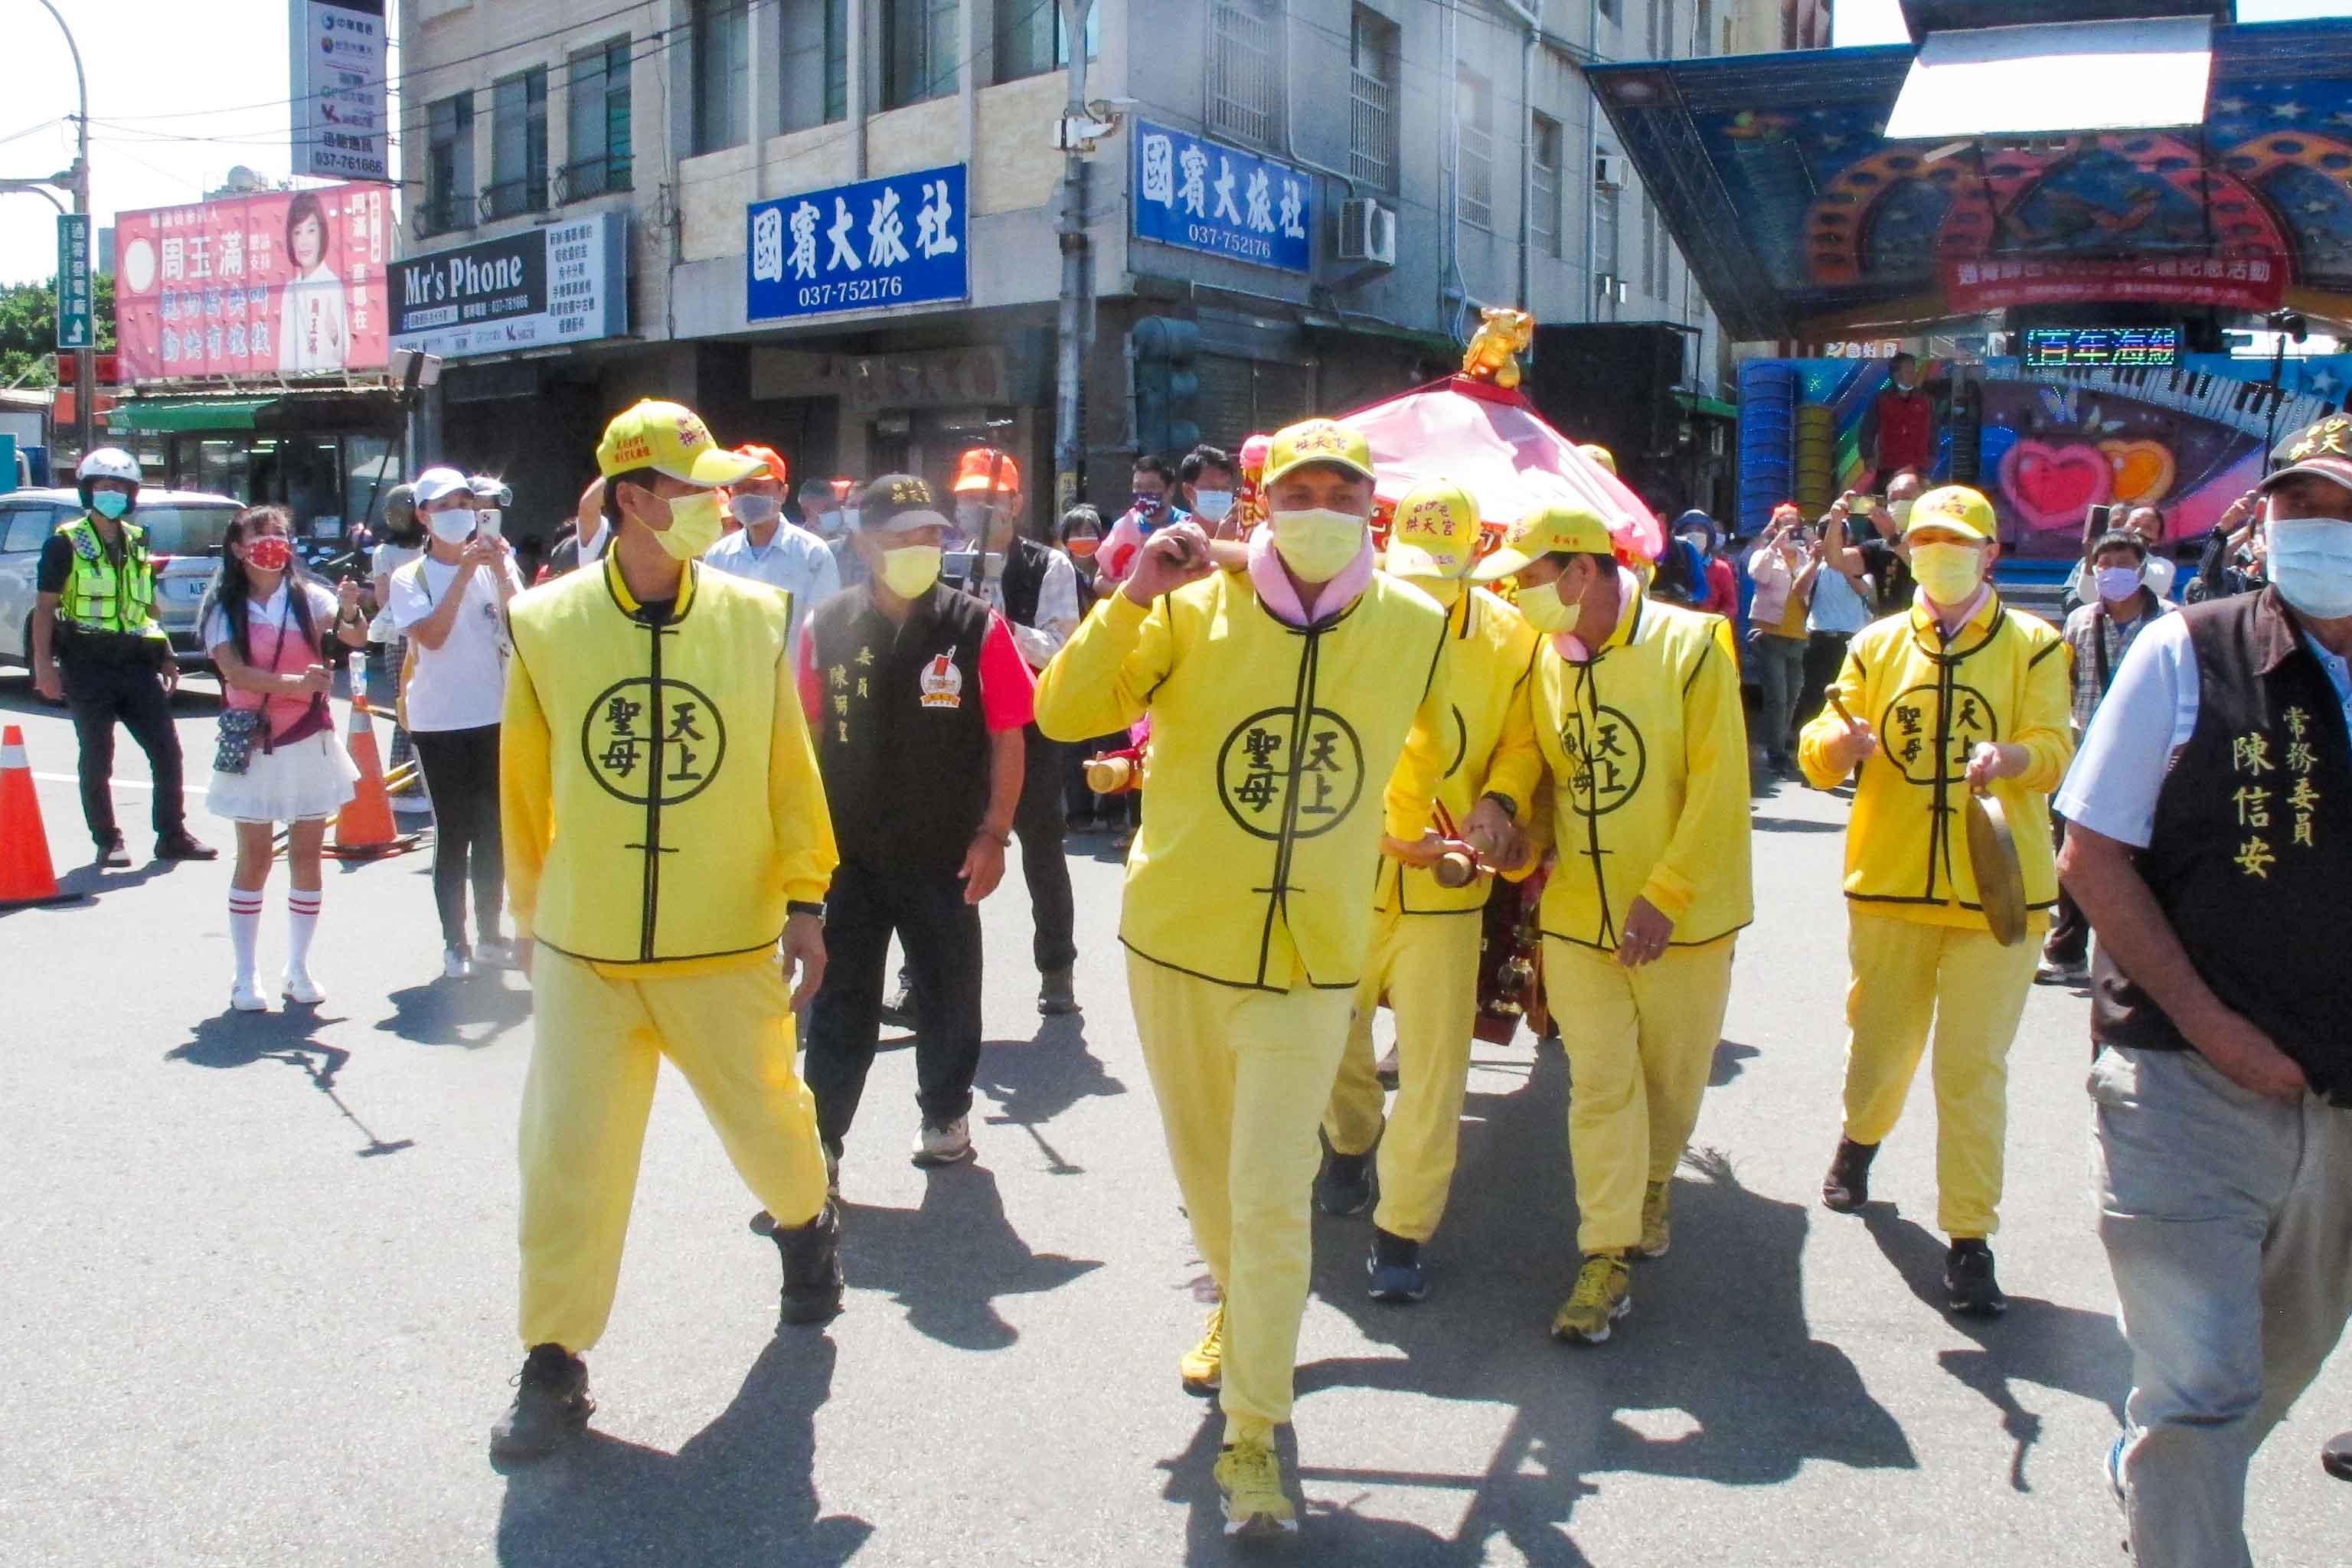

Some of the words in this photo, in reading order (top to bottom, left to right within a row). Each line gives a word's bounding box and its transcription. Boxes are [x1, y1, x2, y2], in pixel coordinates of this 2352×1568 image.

[1142, 134, 1305, 240] 國賓大旅社
[753, 180, 958, 283] 國賓大旅社
[1189, 224, 1271, 258] 037-752176
[404, 262, 445, 305] Mr's
[449, 255, 523, 298] Phone
[799, 276, 902, 306] 037-752176
[1406, 516, 1455, 536] 拱天宮
[2231, 731, 2277, 879] 陳信安
[2282, 705, 2321, 848] 常務委員
